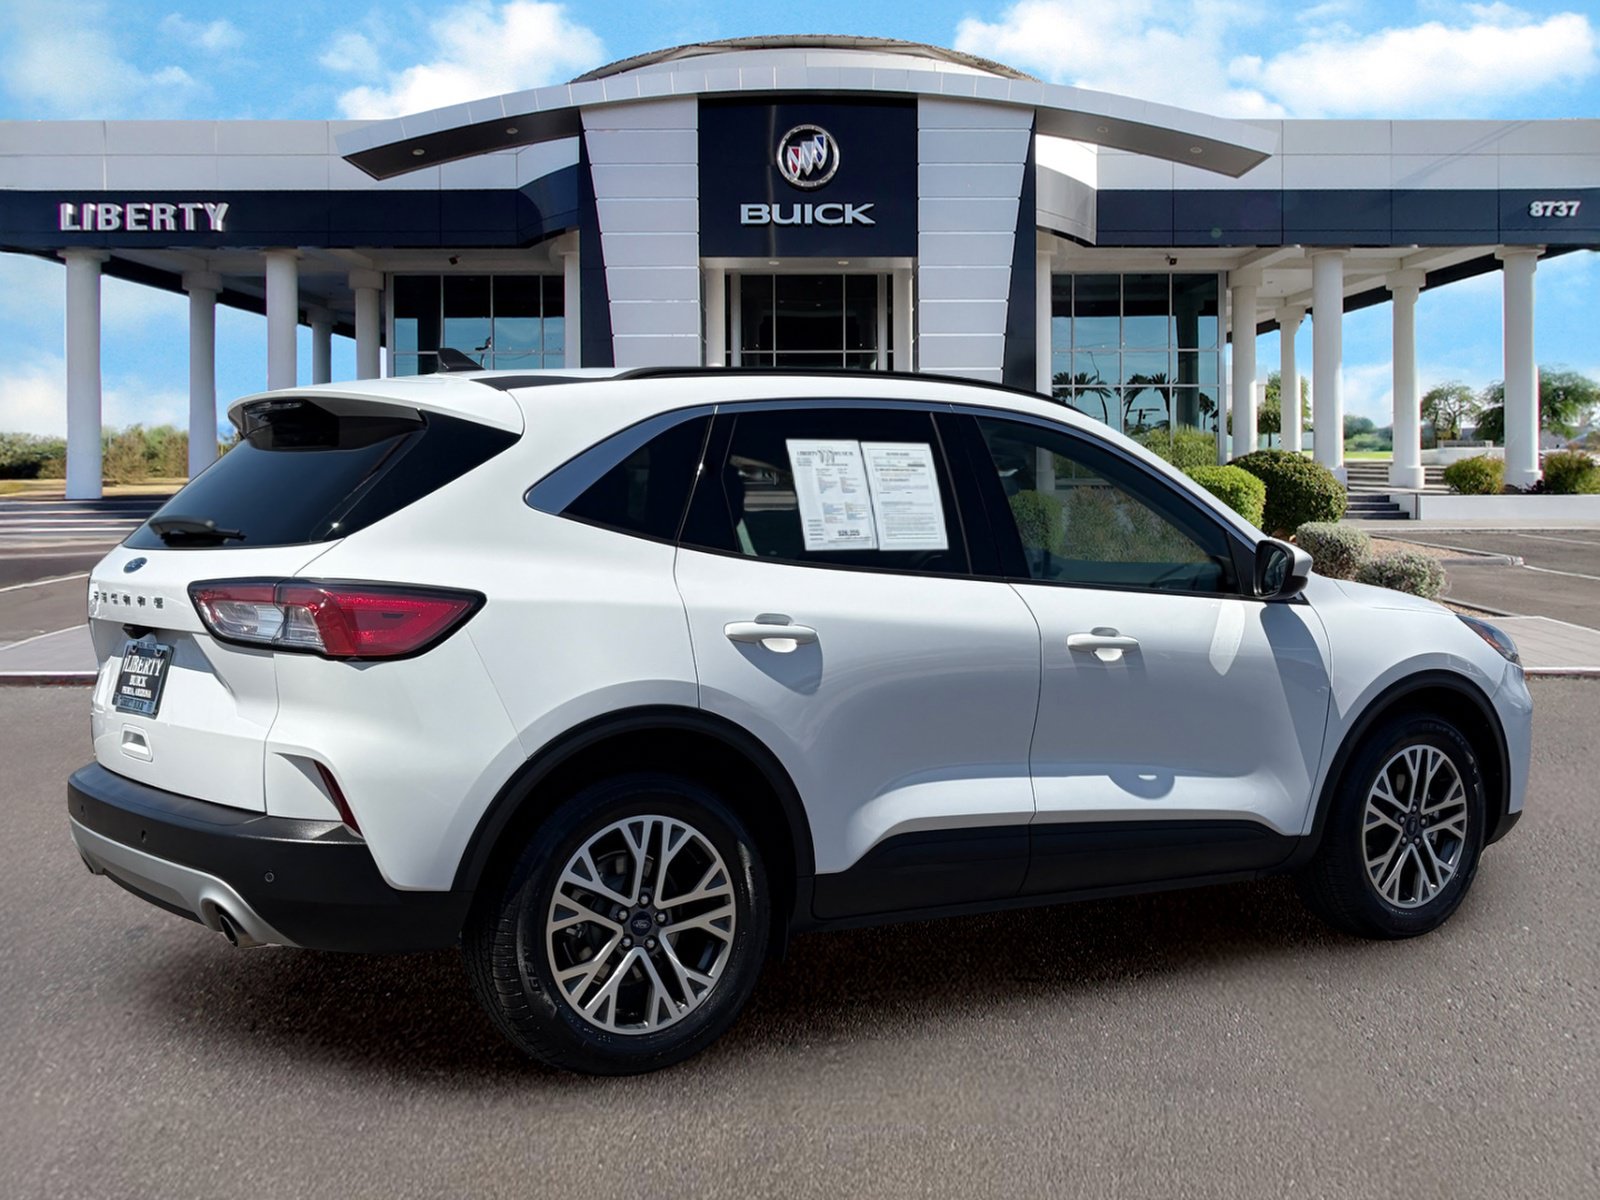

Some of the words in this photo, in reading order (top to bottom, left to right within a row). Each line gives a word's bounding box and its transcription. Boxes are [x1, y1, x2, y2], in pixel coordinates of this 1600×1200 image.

[59, 203, 229, 232] LIBERTY
[740, 203, 876, 225] BUICK
[1529, 201, 1581, 217] 8737
[124, 655, 165, 676] LIBERTY
